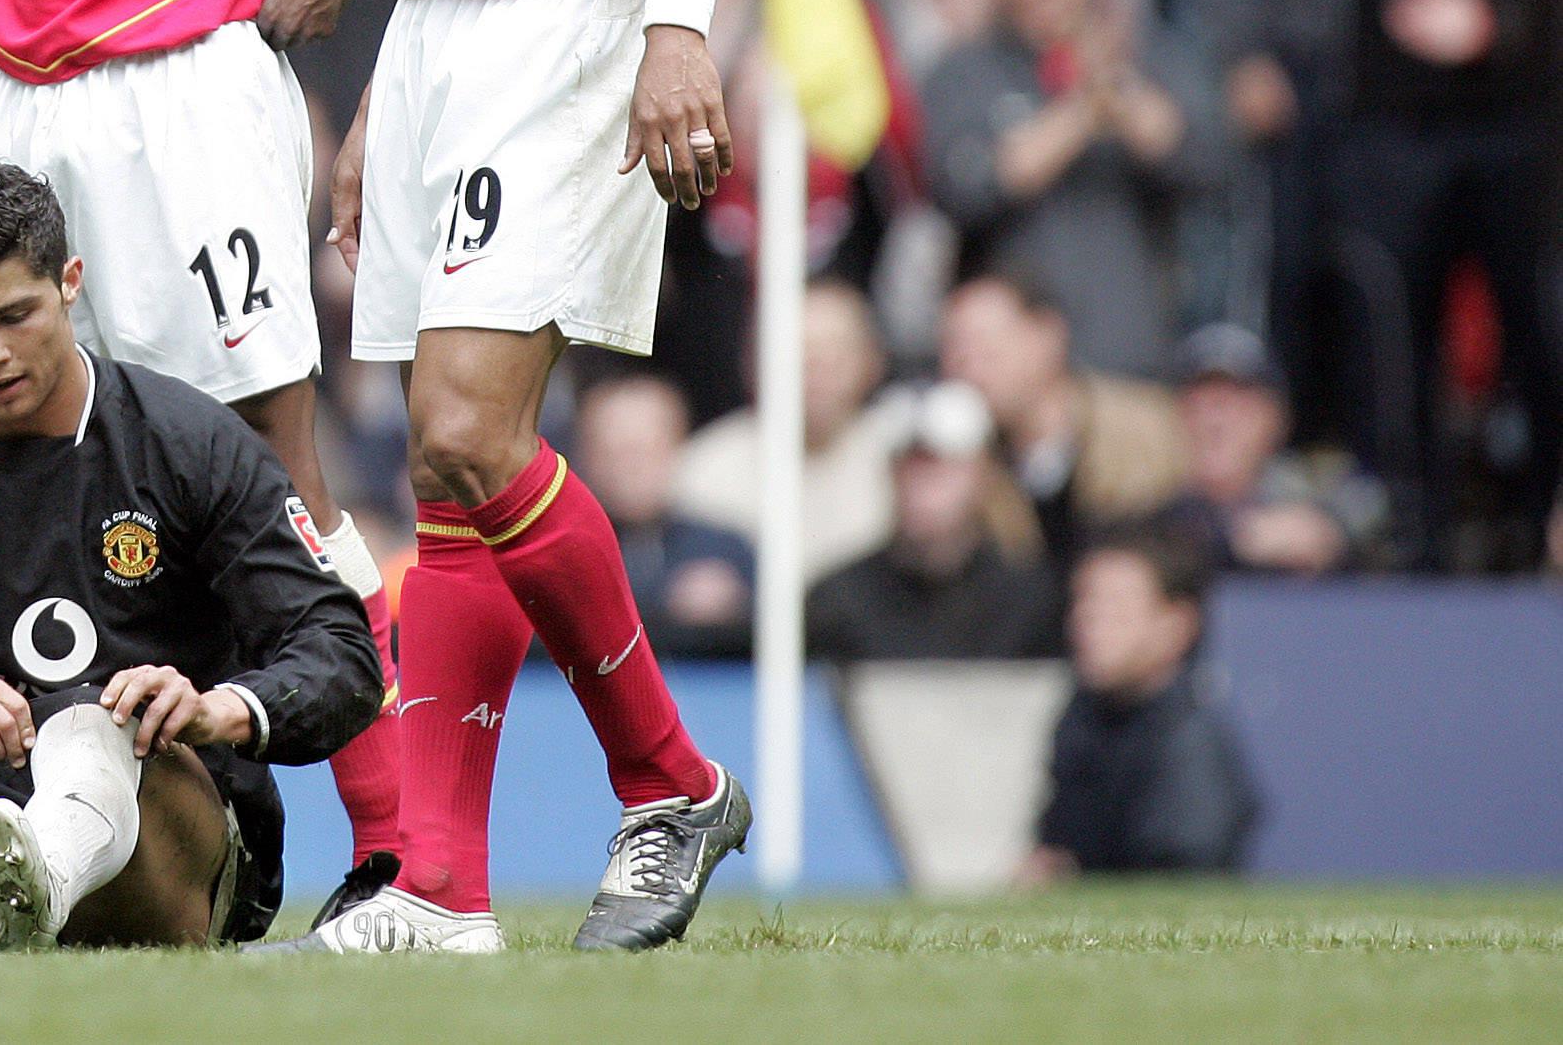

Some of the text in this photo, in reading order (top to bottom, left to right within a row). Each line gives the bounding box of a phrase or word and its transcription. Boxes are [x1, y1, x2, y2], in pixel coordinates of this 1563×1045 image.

[446, 167, 502, 254] 19
[188, 226, 274, 329] 12
[101, 510, 158, 531] FA CUP FINAL
[104, 569, 141, 587] CARDIFF
